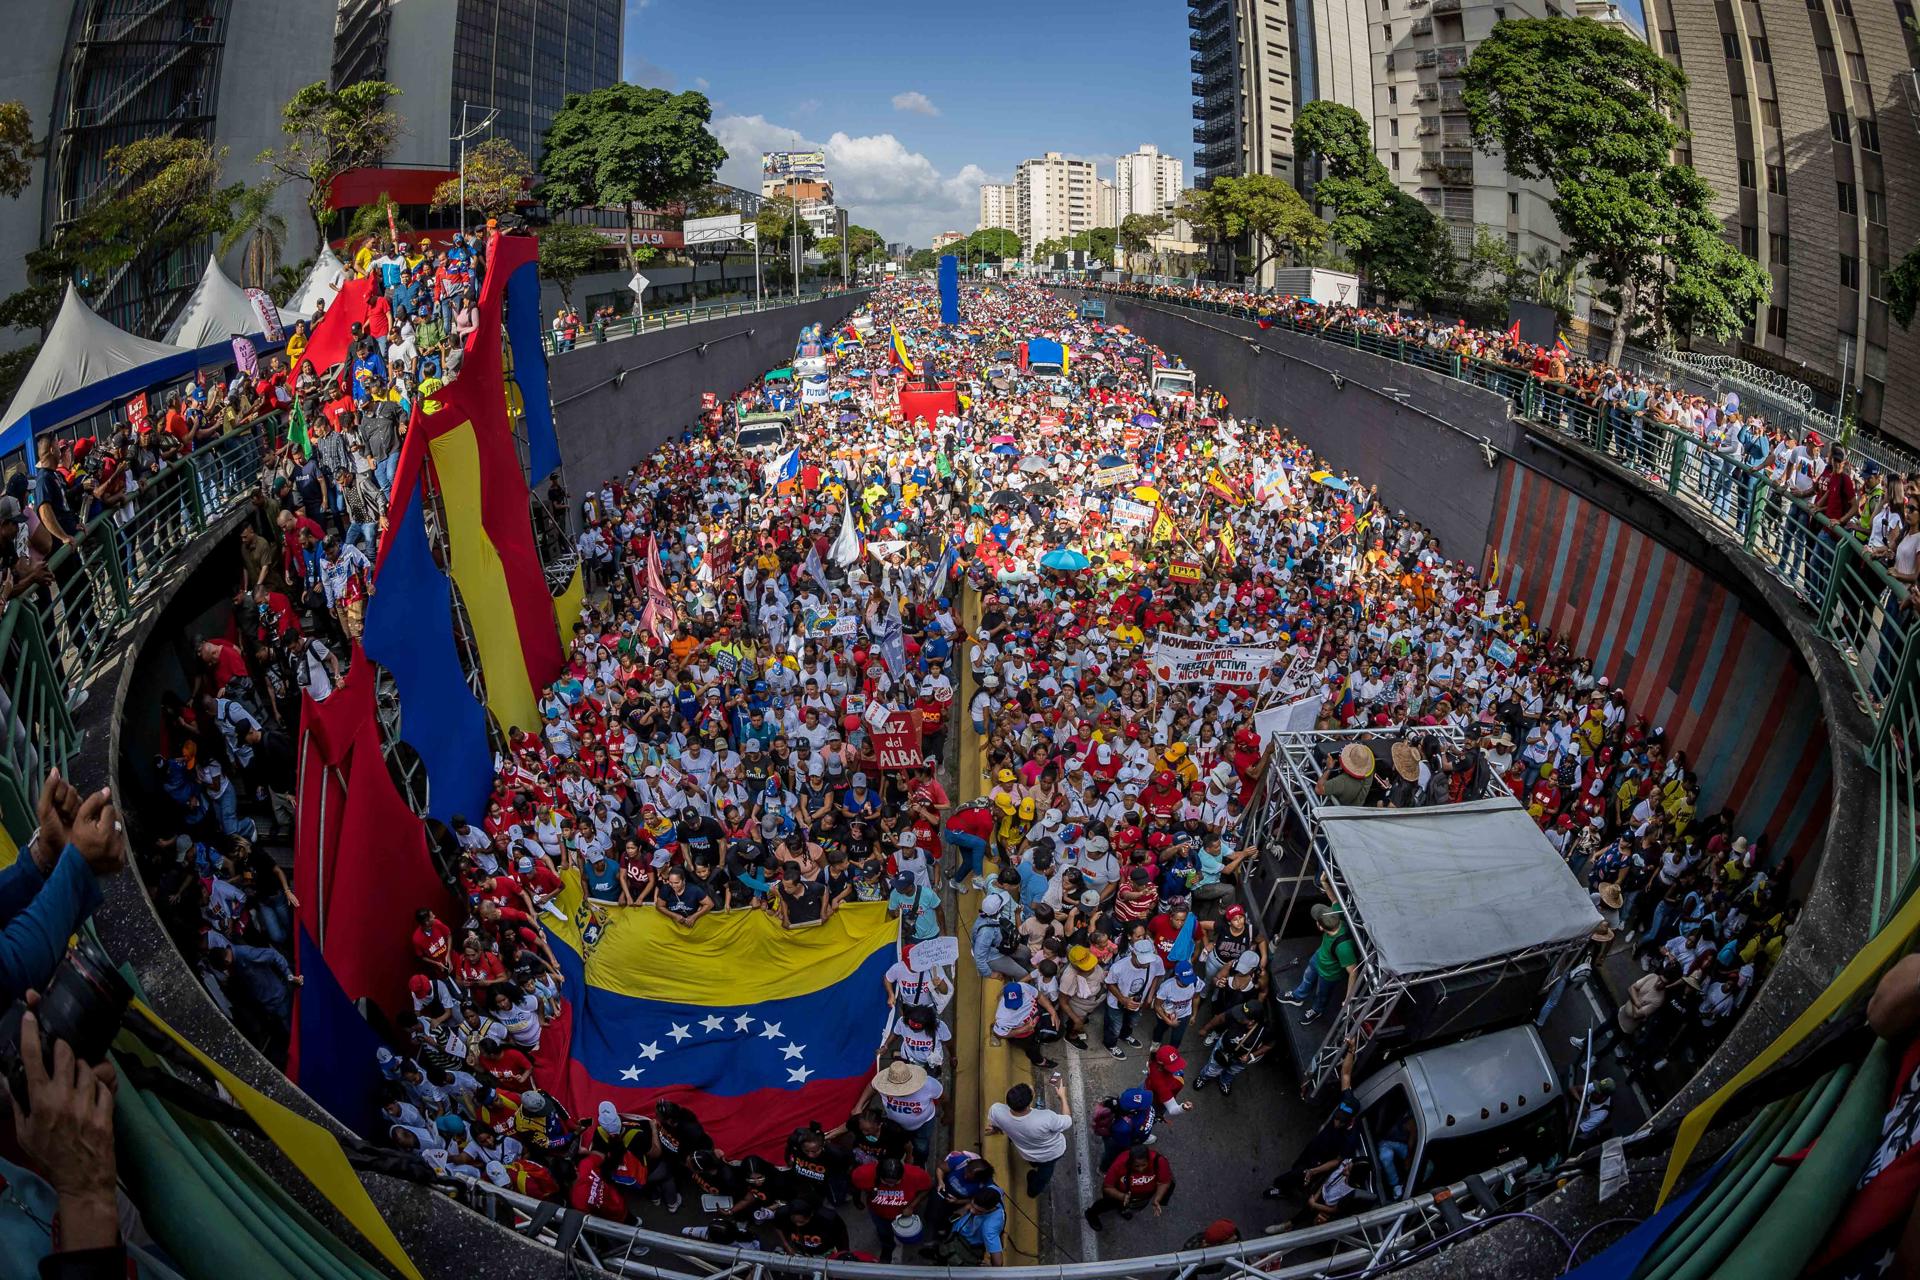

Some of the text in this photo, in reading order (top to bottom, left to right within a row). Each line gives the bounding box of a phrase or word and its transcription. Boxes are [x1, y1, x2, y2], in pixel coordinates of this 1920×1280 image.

[1743, 346, 1776, 367] TORRE
[1178, 670, 1253, 681] NICO PINTO
[885, 737, 902, 748] del
[880, 748, 922, 767] ALBA
[886, 1096, 921, 1107] Vamos
